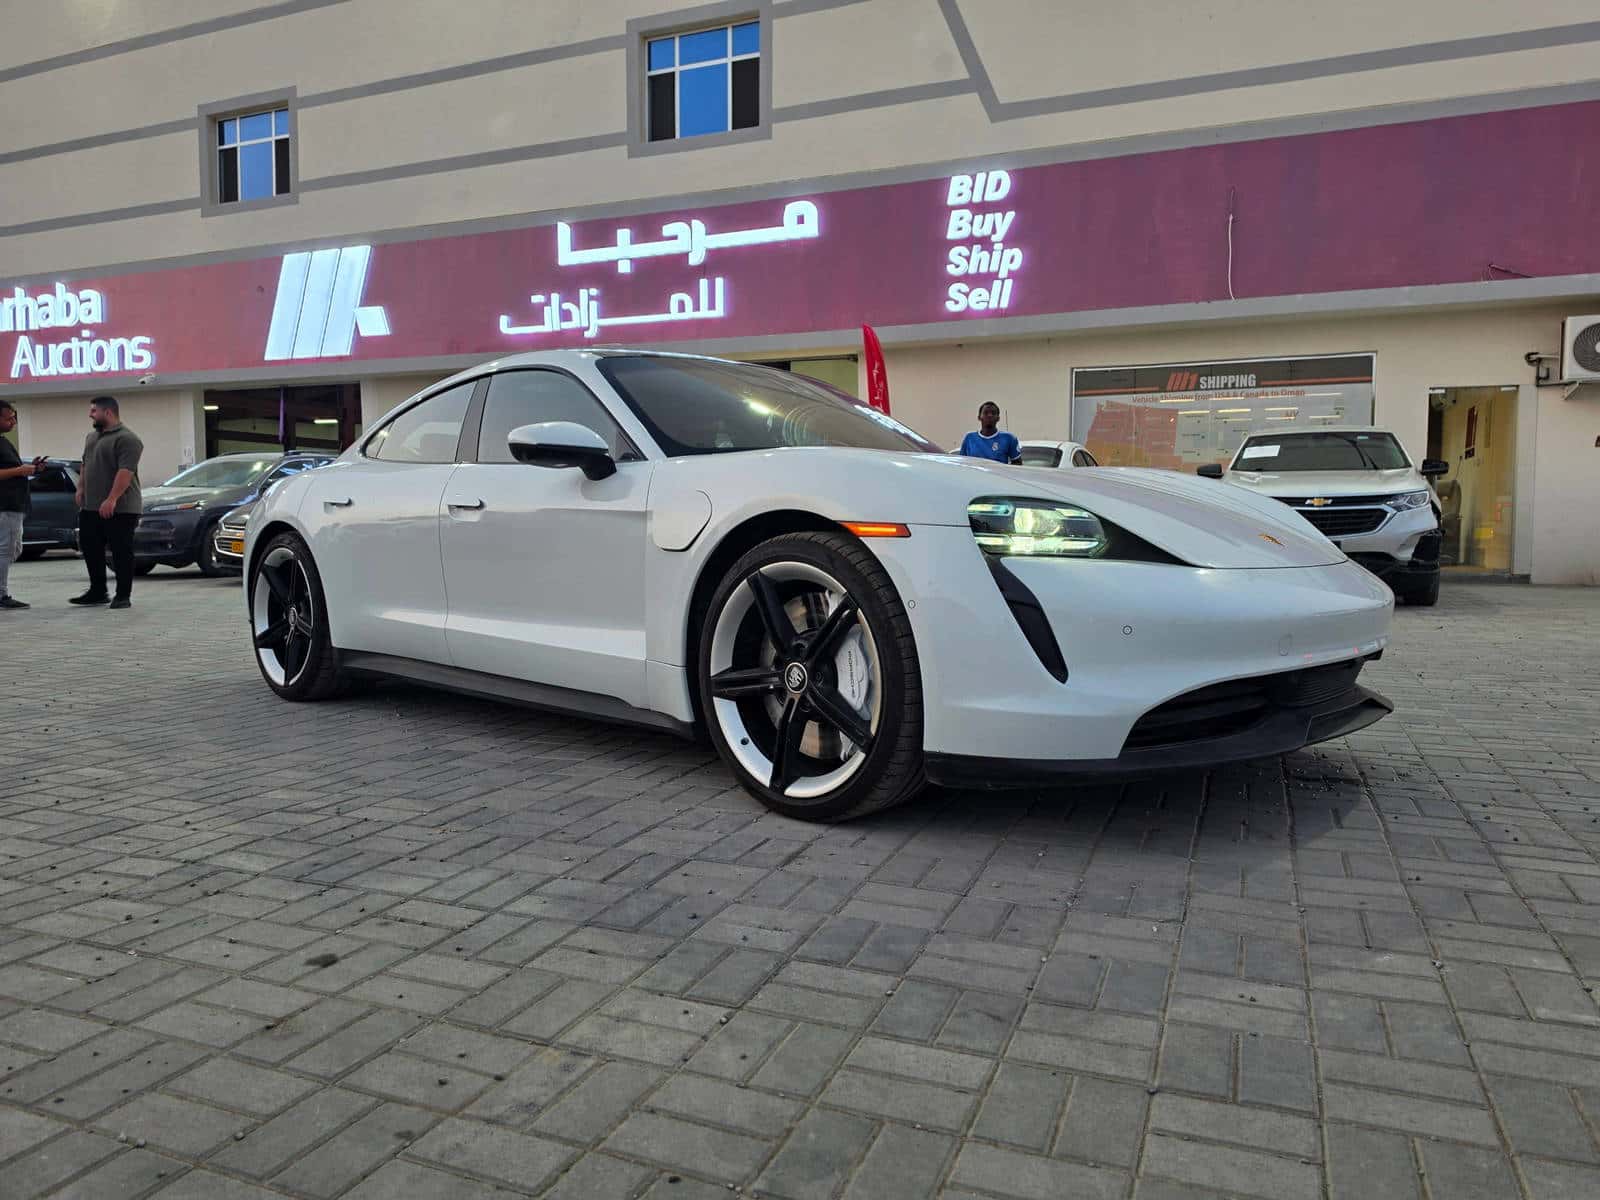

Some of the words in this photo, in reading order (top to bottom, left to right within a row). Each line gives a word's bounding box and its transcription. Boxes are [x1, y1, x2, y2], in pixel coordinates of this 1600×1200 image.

[946, 169, 1012, 206] BID
[556, 200, 819, 274] مرحبا
[946, 208, 1016, 242] Buy
[946, 242, 1023, 279] Ship
[0, 281, 103, 332] rhaba
[499, 276, 725, 339] للمزادات
[945, 278, 1013, 313] Sell
[10, 329, 153, 378] Auctions
[1199, 373, 1257, 390] SHIPPING
